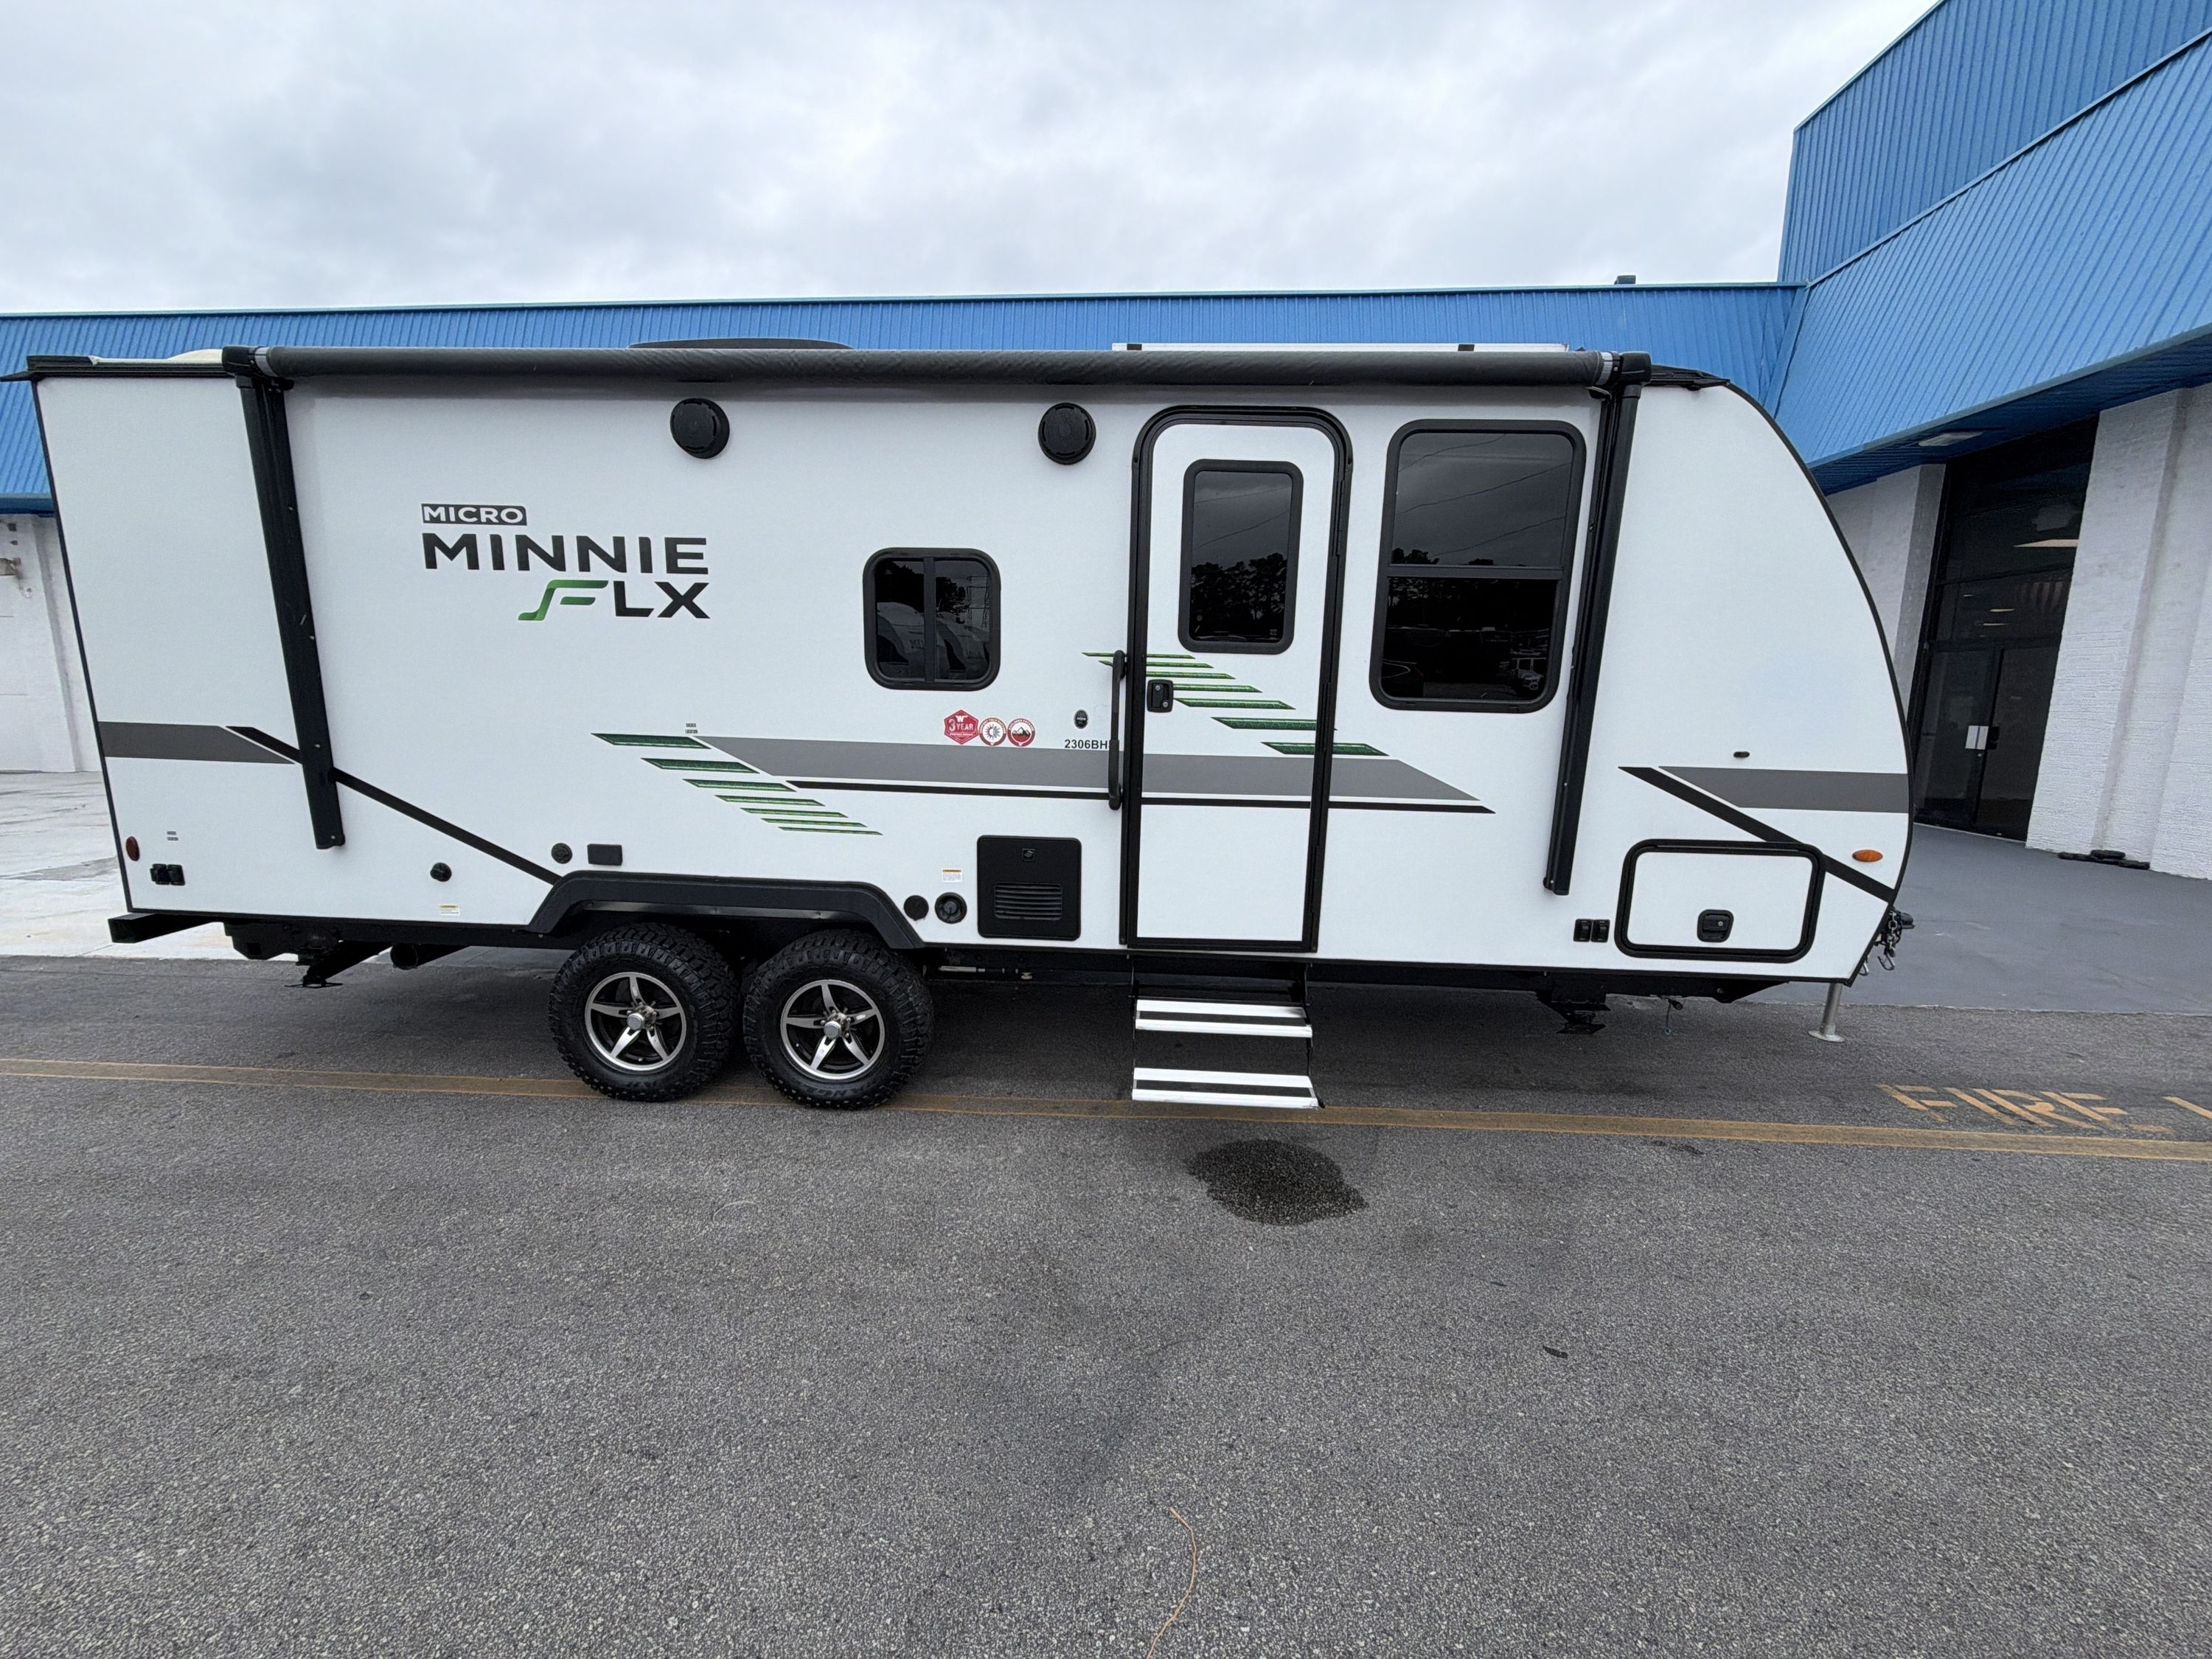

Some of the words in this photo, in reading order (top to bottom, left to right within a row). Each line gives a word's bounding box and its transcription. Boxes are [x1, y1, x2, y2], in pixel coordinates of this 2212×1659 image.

[424, 506, 524, 523] MICRO
[422, 533, 709, 574] MINNIE
[518, 580, 711, 621] FLX
[948, 718, 956, 731] 3
[956, 723, 974, 731] YEAR
[1064, 739, 1110, 749] 2306BH
[1877, 1084, 2172, 1132] FIRE
